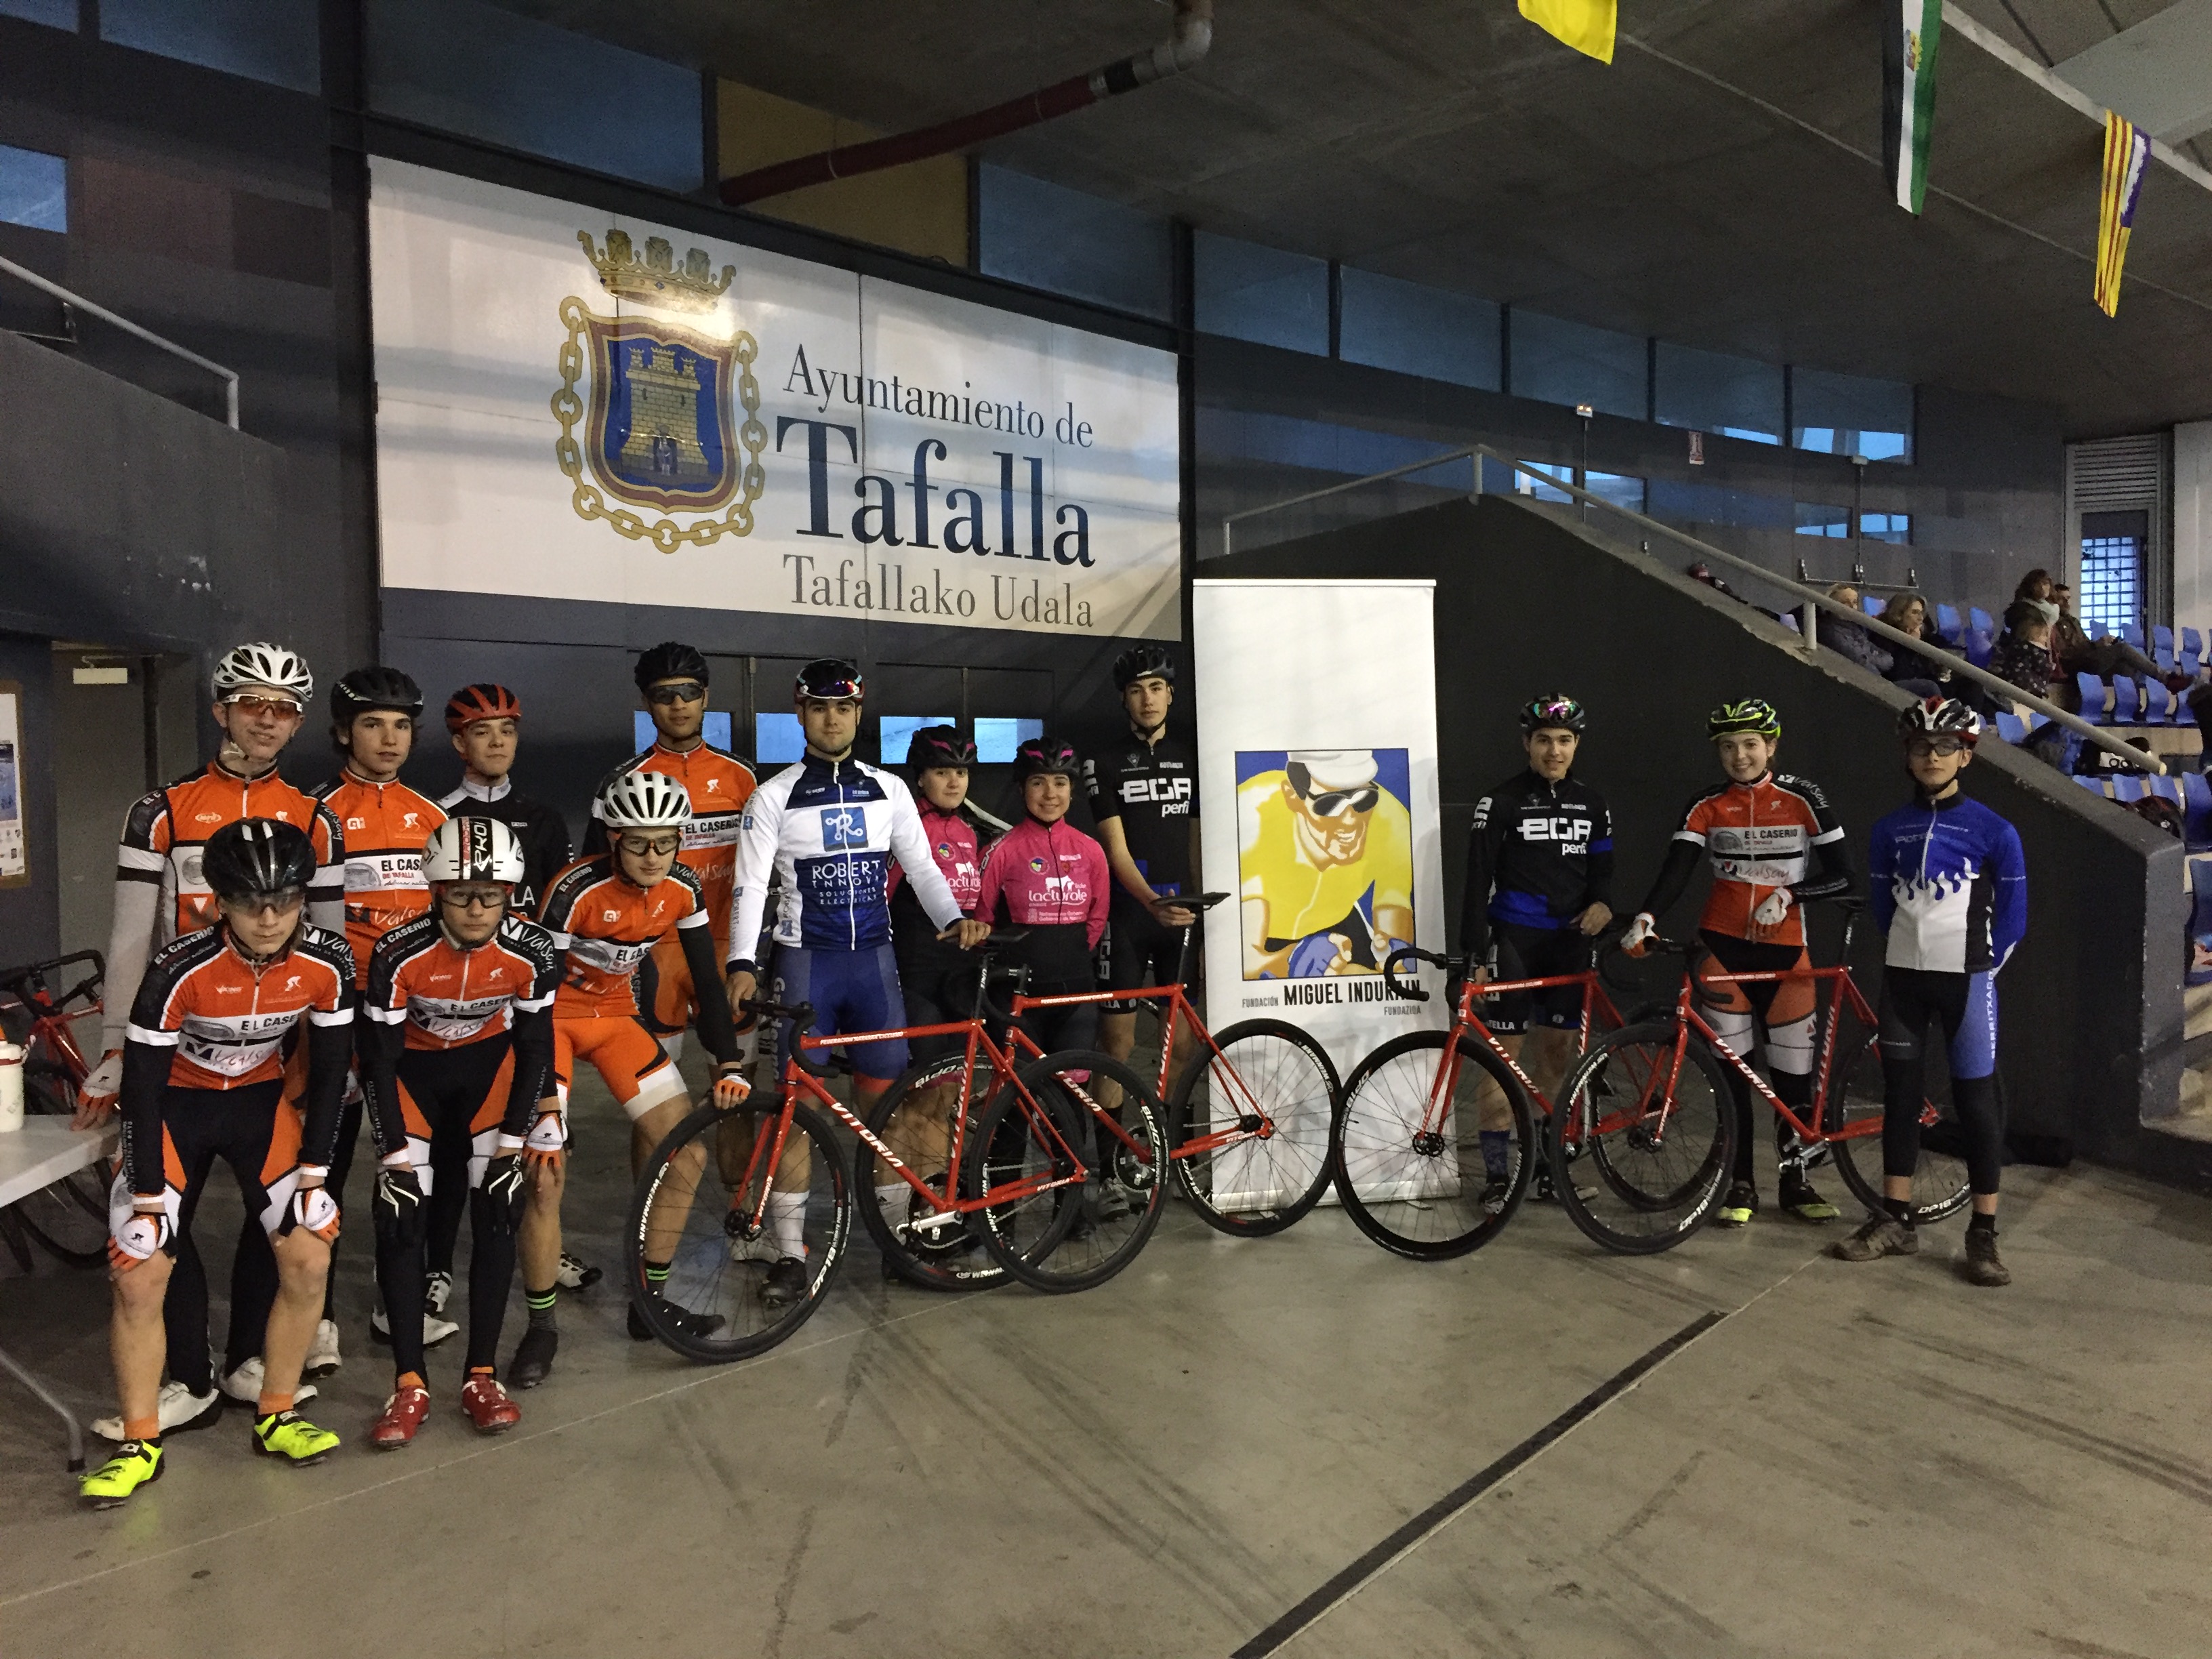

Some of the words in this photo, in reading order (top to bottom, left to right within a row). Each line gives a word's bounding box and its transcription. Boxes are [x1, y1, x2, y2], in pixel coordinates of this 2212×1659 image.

[783, 344, 1044, 438] Ayuntamiento
[1056, 402, 1093, 448] de
[777, 415, 1096, 568] Tafalla
[783, 554, 975, 617] Tafallako
[991, 575, 1093, 628] Udala
[685, 823, 697, 834] EL
[1744, 830, 1757, 839] EL
[1760, 829, 1797, 838] CASERIO
[381, 861, 394, 871] EL
[812, 860, 880, 880] ROBERT
[559, 883, 569, 893] EL
[1028, 888, 1088, 902] lacturale
[155, 952, 167, 964] EL
[167, 926, 215, 954] CASERIO
[375, 943, 388, 953] EL
[387, 918, 432, 943] CASERIO
[616, 949, 627, 962] EL
[1242, 996, 1279, 1008] FUNDACIÓN
[1284, 983, 1343, 1005] MIGUEL
[241, 1021, 259, 1031] EL
[1715, 1038, 1776, 1098] VITORIA
[831, 1102, 904, 1167] VITORIA
[1037, 1178, 1070, 1191] VITORIA
[639, 1178, 661, 1241] WEINMANN
[812, 1246, 836, 1295] DP18
